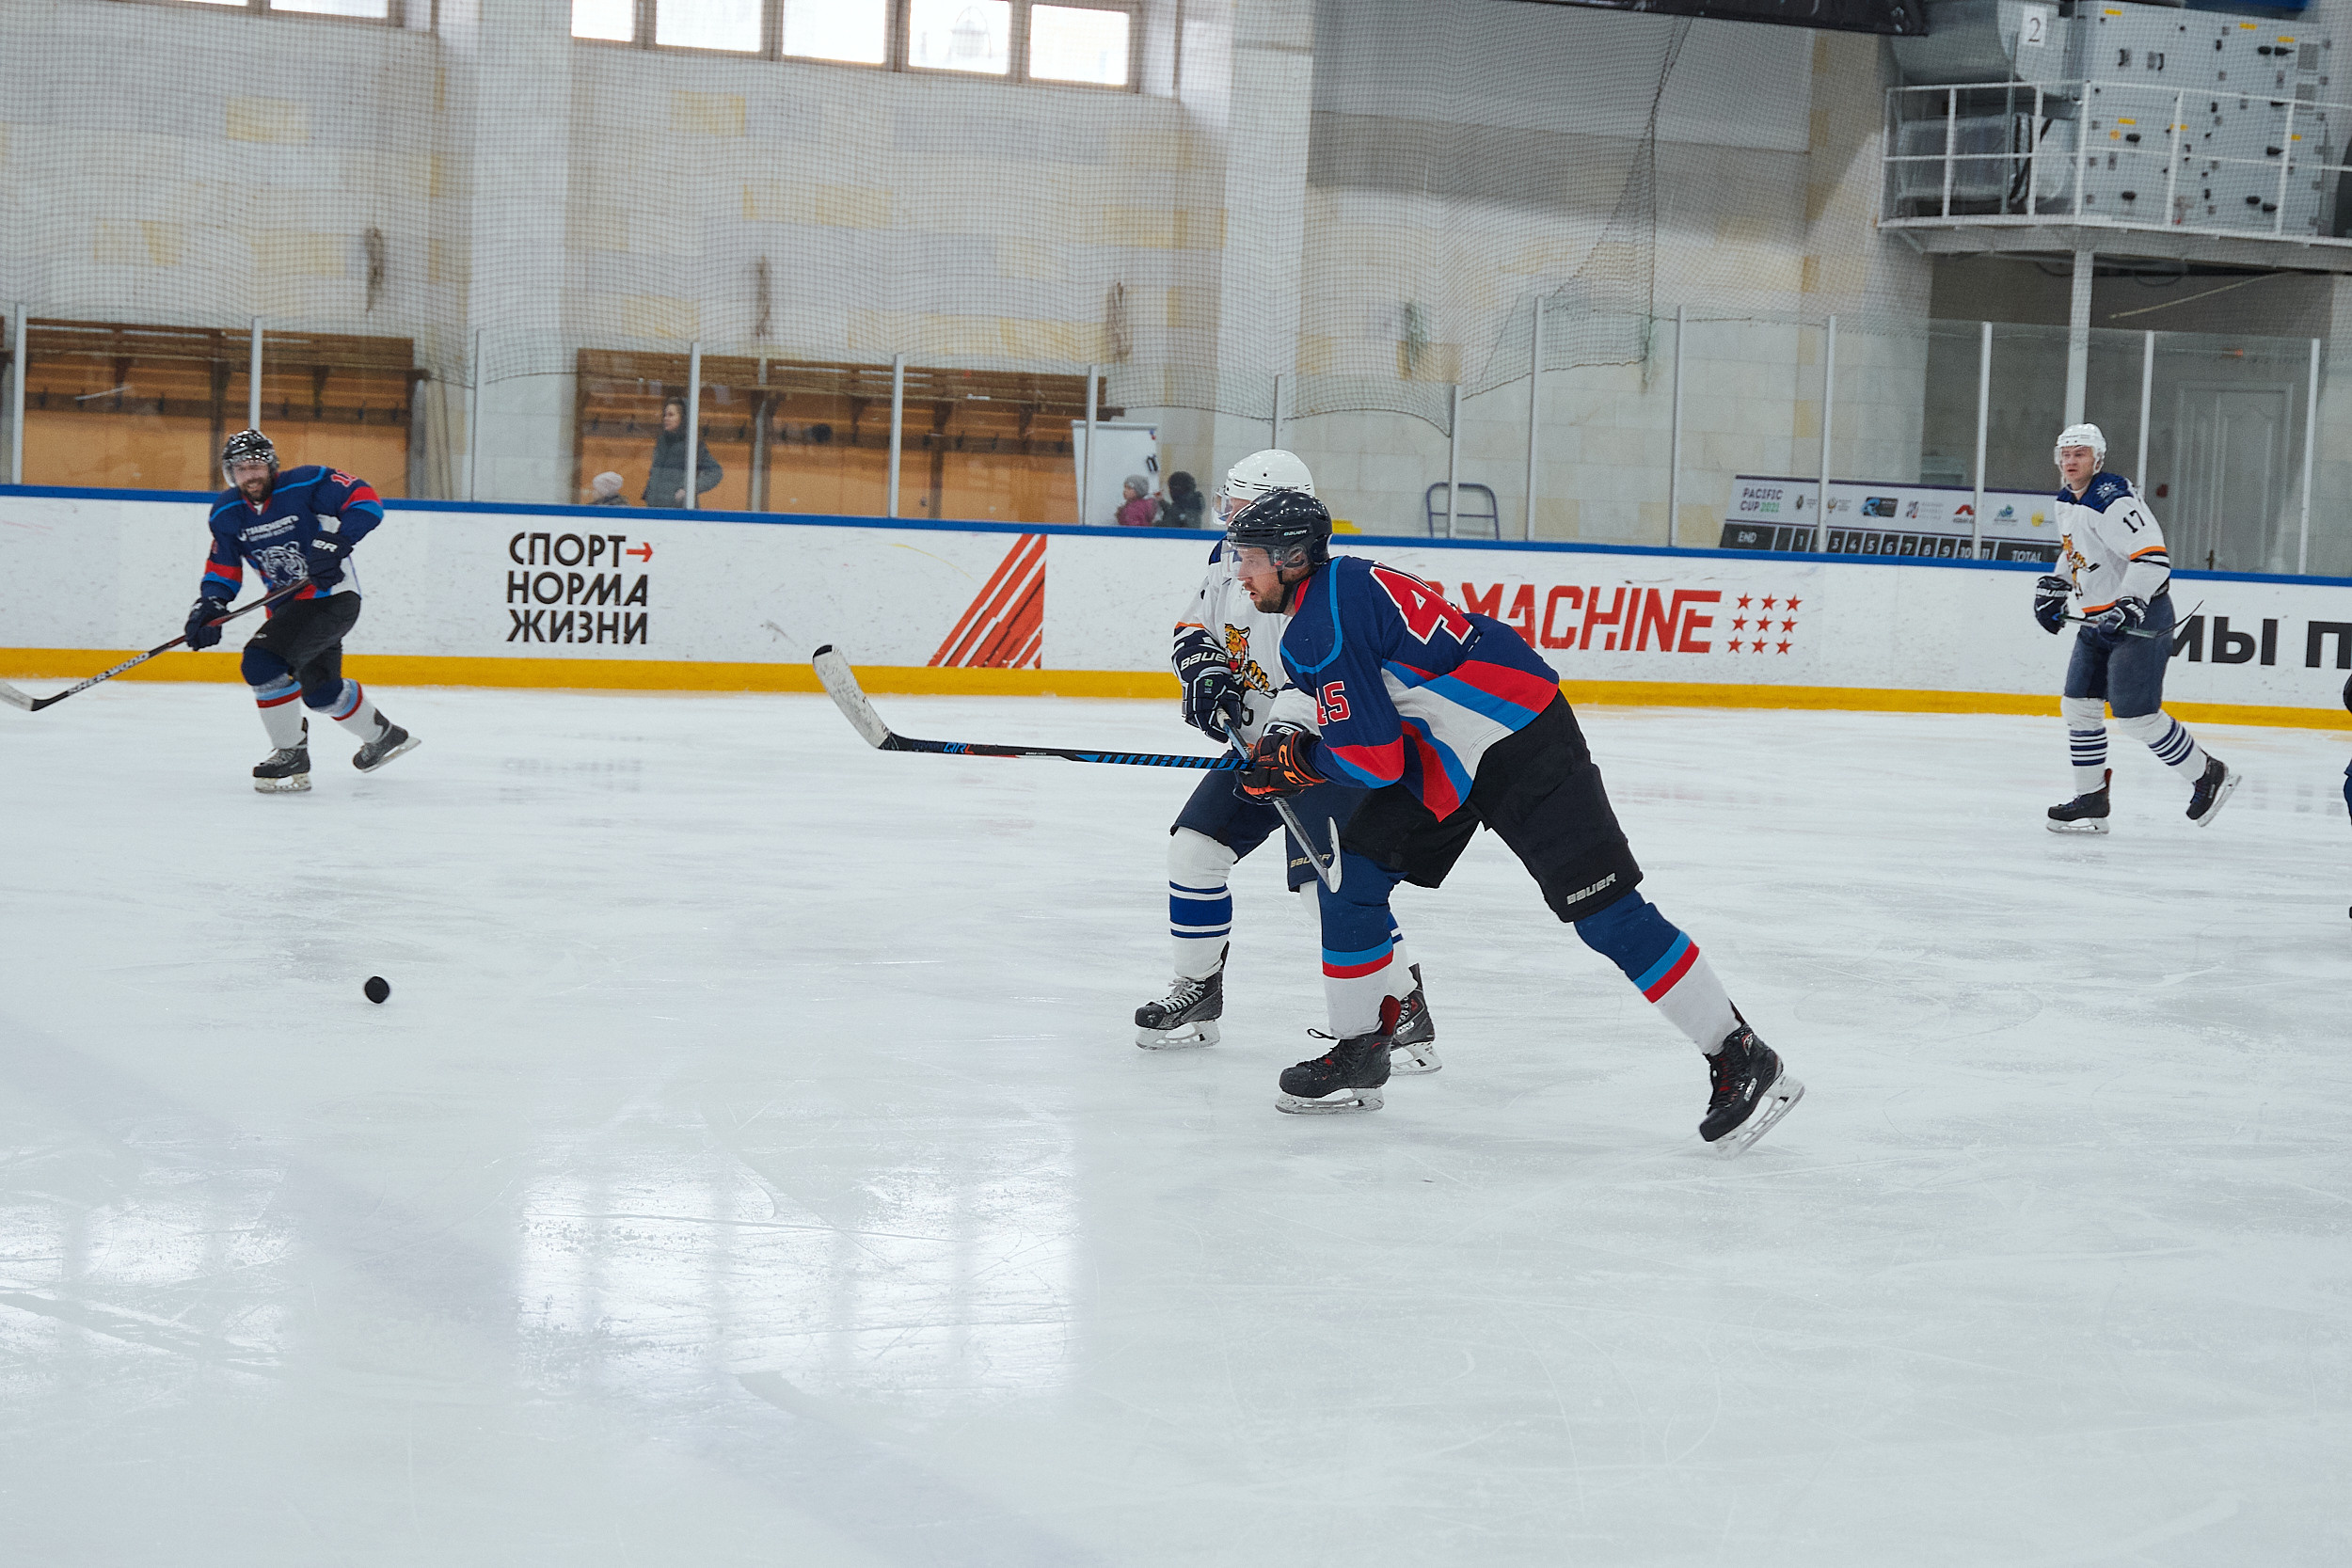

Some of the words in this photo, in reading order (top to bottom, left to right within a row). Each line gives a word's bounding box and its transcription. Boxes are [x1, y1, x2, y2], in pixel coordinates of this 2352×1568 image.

[2028, 17, 2041, 42] 2
[1740, 500, 1760, 512] CUP
[1760, 501, 1780, 513] 2021
[1742, 487, 1784, 500] PACIFIC
[2122, 509, 2146, 534] 17
[509, 532, 626, 567] СПОРТ
[1738, 531, 1757, 544] END
[1798, 535, 1804, 546] 1
[1850, 540, 1857, 549] 4
[1867, 541, 1875, 551] 5
[1885, 542, 1893, 553] 6
[1905, 543, 1912, 554] 7
[1923, 545, 1931, 556] 8
[1942, 546, 1950, 557] 9
[1960, 547, 1972, 558] 10
[2011, 550, 2042, 562] TOTAL
[507, 571, 648, 606] НОРМА
[506, 610, 647, 644] ЖИЗНИ
[1461, 581, 1723, 654] MACHINE
[2171, 615, 2278, 666] МЫ
[1566, 872, 1616, 905] BAUER
